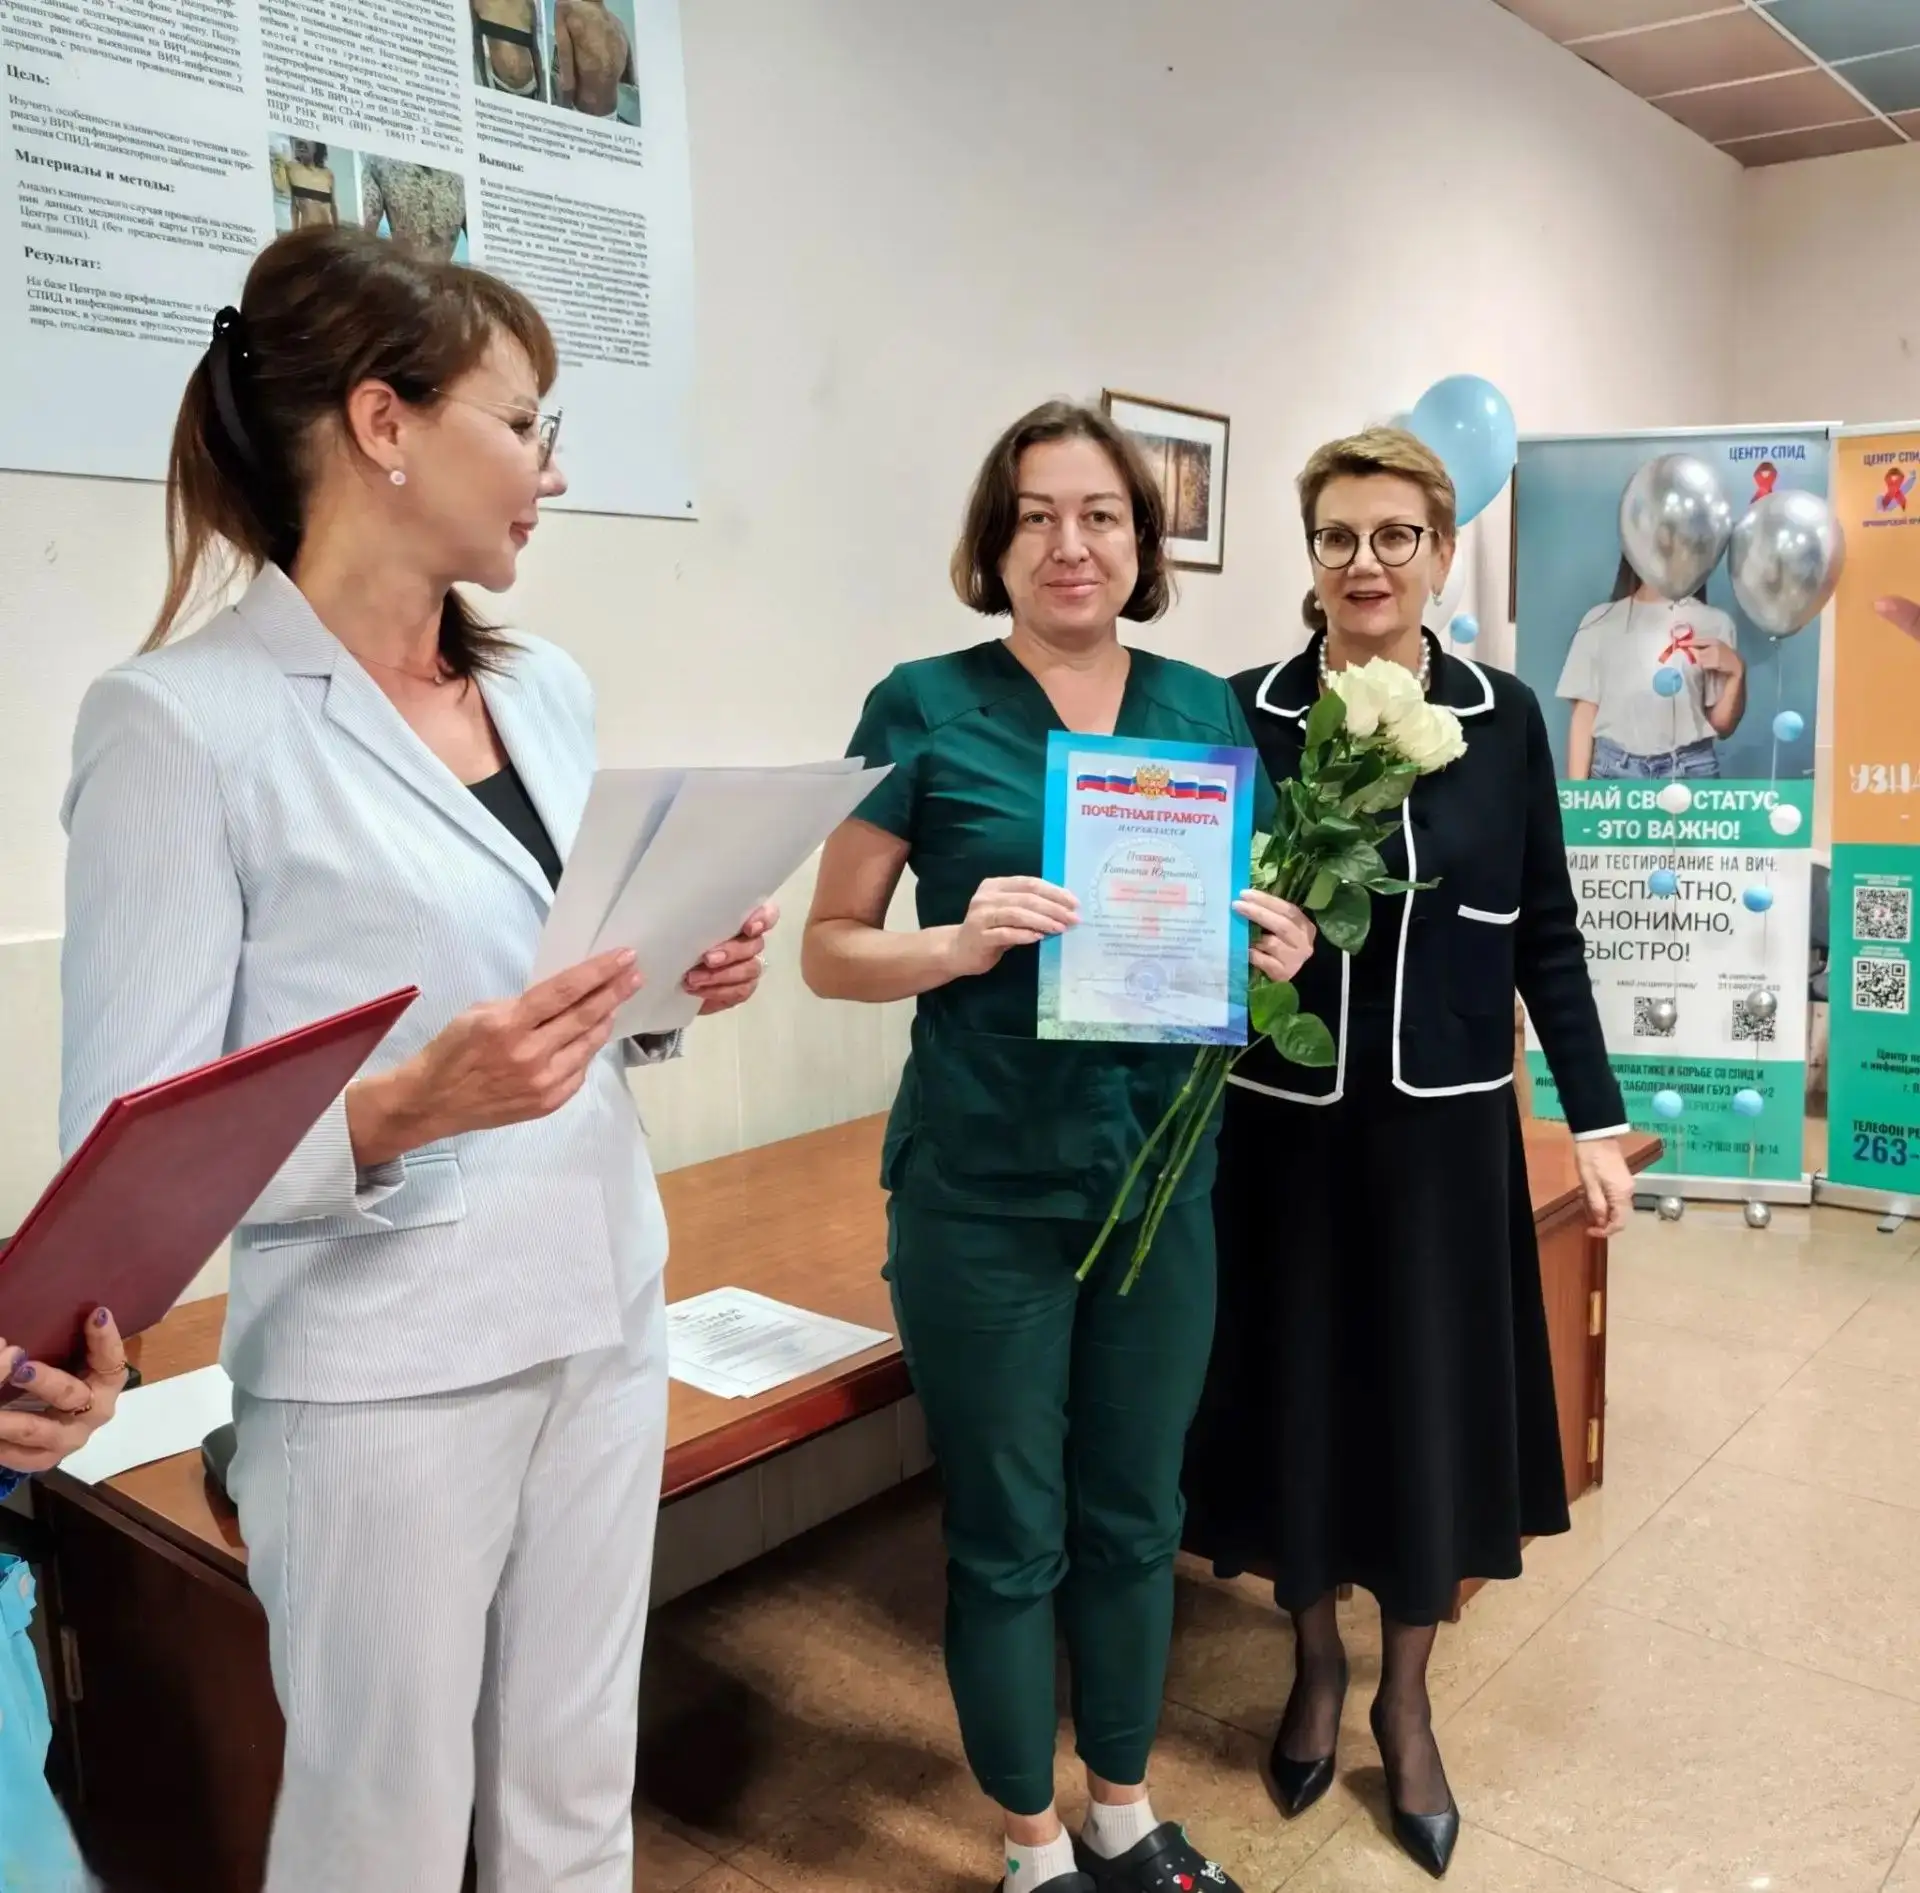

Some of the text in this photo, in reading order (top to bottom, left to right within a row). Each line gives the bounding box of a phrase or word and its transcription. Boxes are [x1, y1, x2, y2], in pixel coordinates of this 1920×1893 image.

[6, 64, 50, 86] Цель:
[55, 107, 121, 128] особенности
[15, 149, 101, 178] Материалы
[119, 174, 175, 193] методы:
[17, 180, 57, 195] Анализ
[20, 205, 58, 222] Центра
[64, 214, 97, 230] СПИД
[44, 200, 83, 217] данных
[24, 246, 101, 270] Результат:
[27, 288, 64, 304] СПИД
[44, 278, 66, 293] базе
[69, 282, 106, 298] Центра
[1729, 444, 1806, 461] ЦЕНТР СПИД
[1863, 453, 1896, 467] ЦЕНТР
[1081, 804, 1220, 826] ПОЧЁТНАЯ ГРАМОТА
[1597, 820, 1641, 838] ЭТО
[1647, 820, 1741, 840] ВАЖНО!
[1567, 852, 1778, 872] ЙДИ ТЕСТИРОВАНИЕ НА ВИЧ:
[1580, 910, 1734, 935] АНОНИМНО,
[1583, 940, 1690, 962] БЫСТРО!
[1877, 1048, 1908, 1063] Центр
[1853, 1120, 1904, 1138] ТЕЛЕФОН
